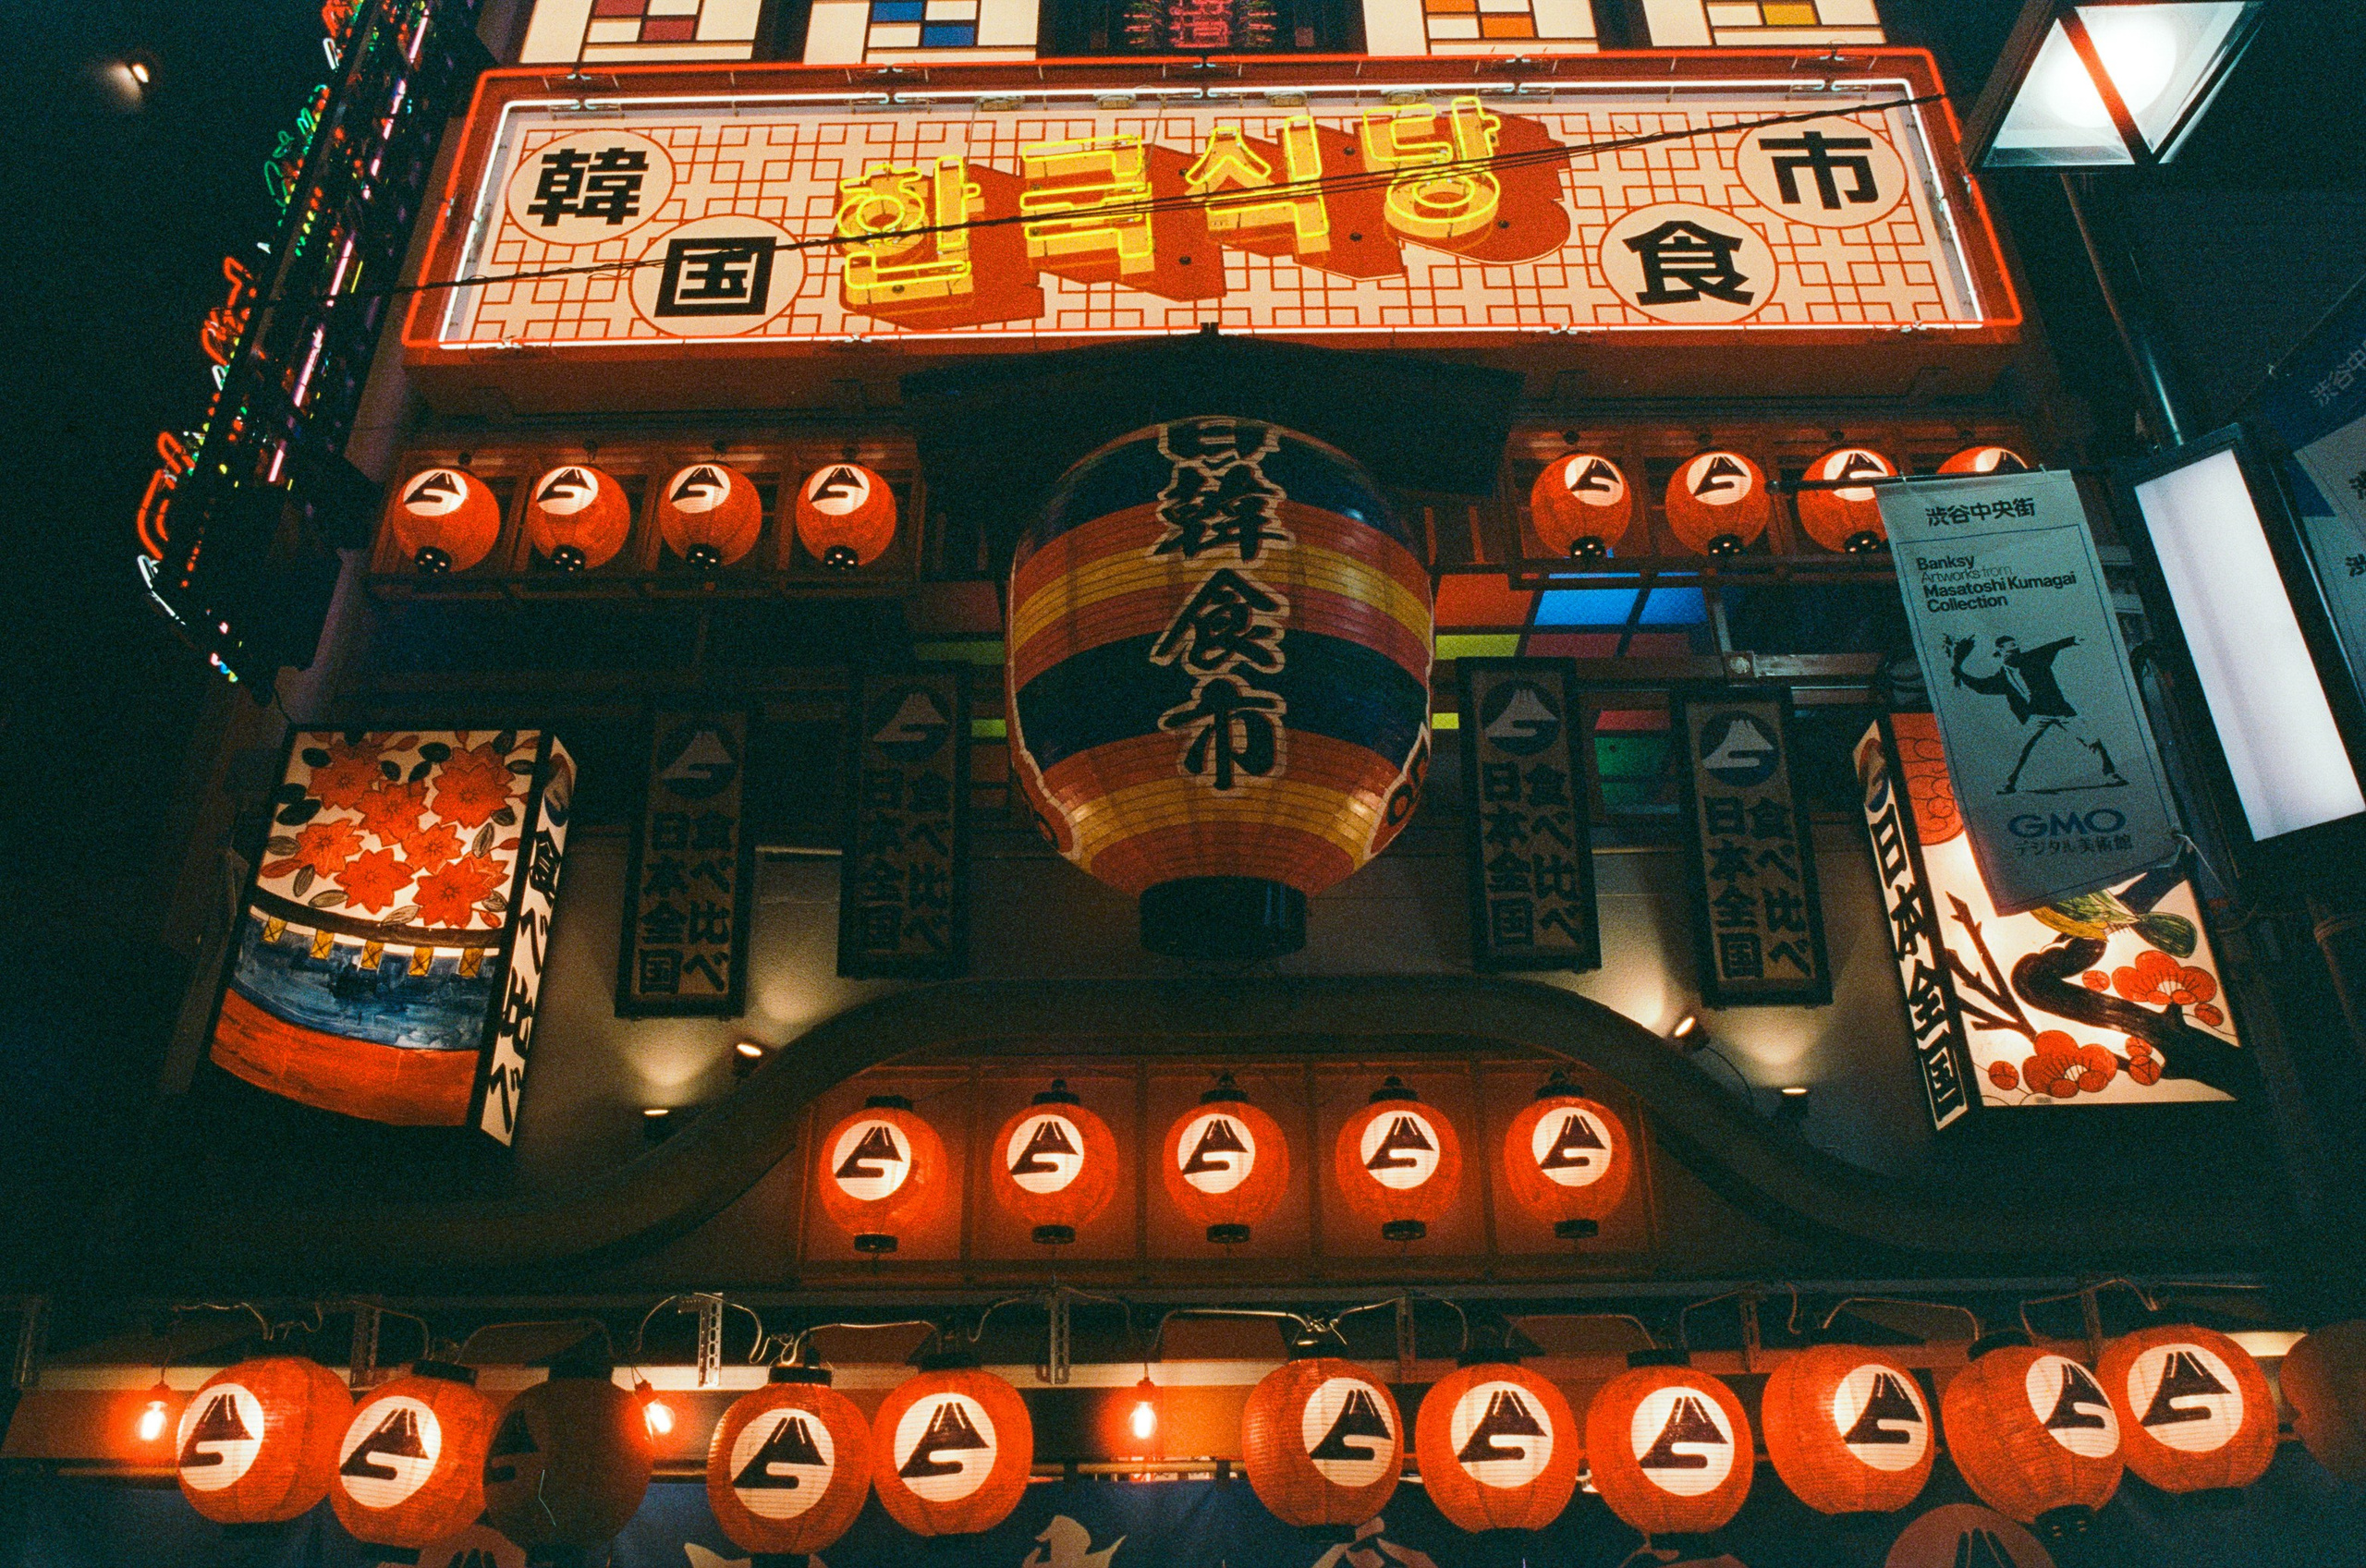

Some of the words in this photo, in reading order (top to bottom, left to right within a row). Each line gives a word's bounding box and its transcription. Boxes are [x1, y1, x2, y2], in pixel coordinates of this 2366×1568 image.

[837, 95, 1501, 310] 한국식당
[1925, 497, 2037, 528] 渋谷中央街
[1916, 555, 1976, 572] Banksy
[1921, 568, 1982, 584] Artworks
[1982, 565, 2012, 578] from
[1923, 578, 2007, 599] Masatoshi
[2007, 571, 2077, 591] Kumagai
[1927, 595, 2008, 613] Collection
[2008, 808, 2127, 838] GMO
[1870, 803, 1967, 1124] 日本全国
